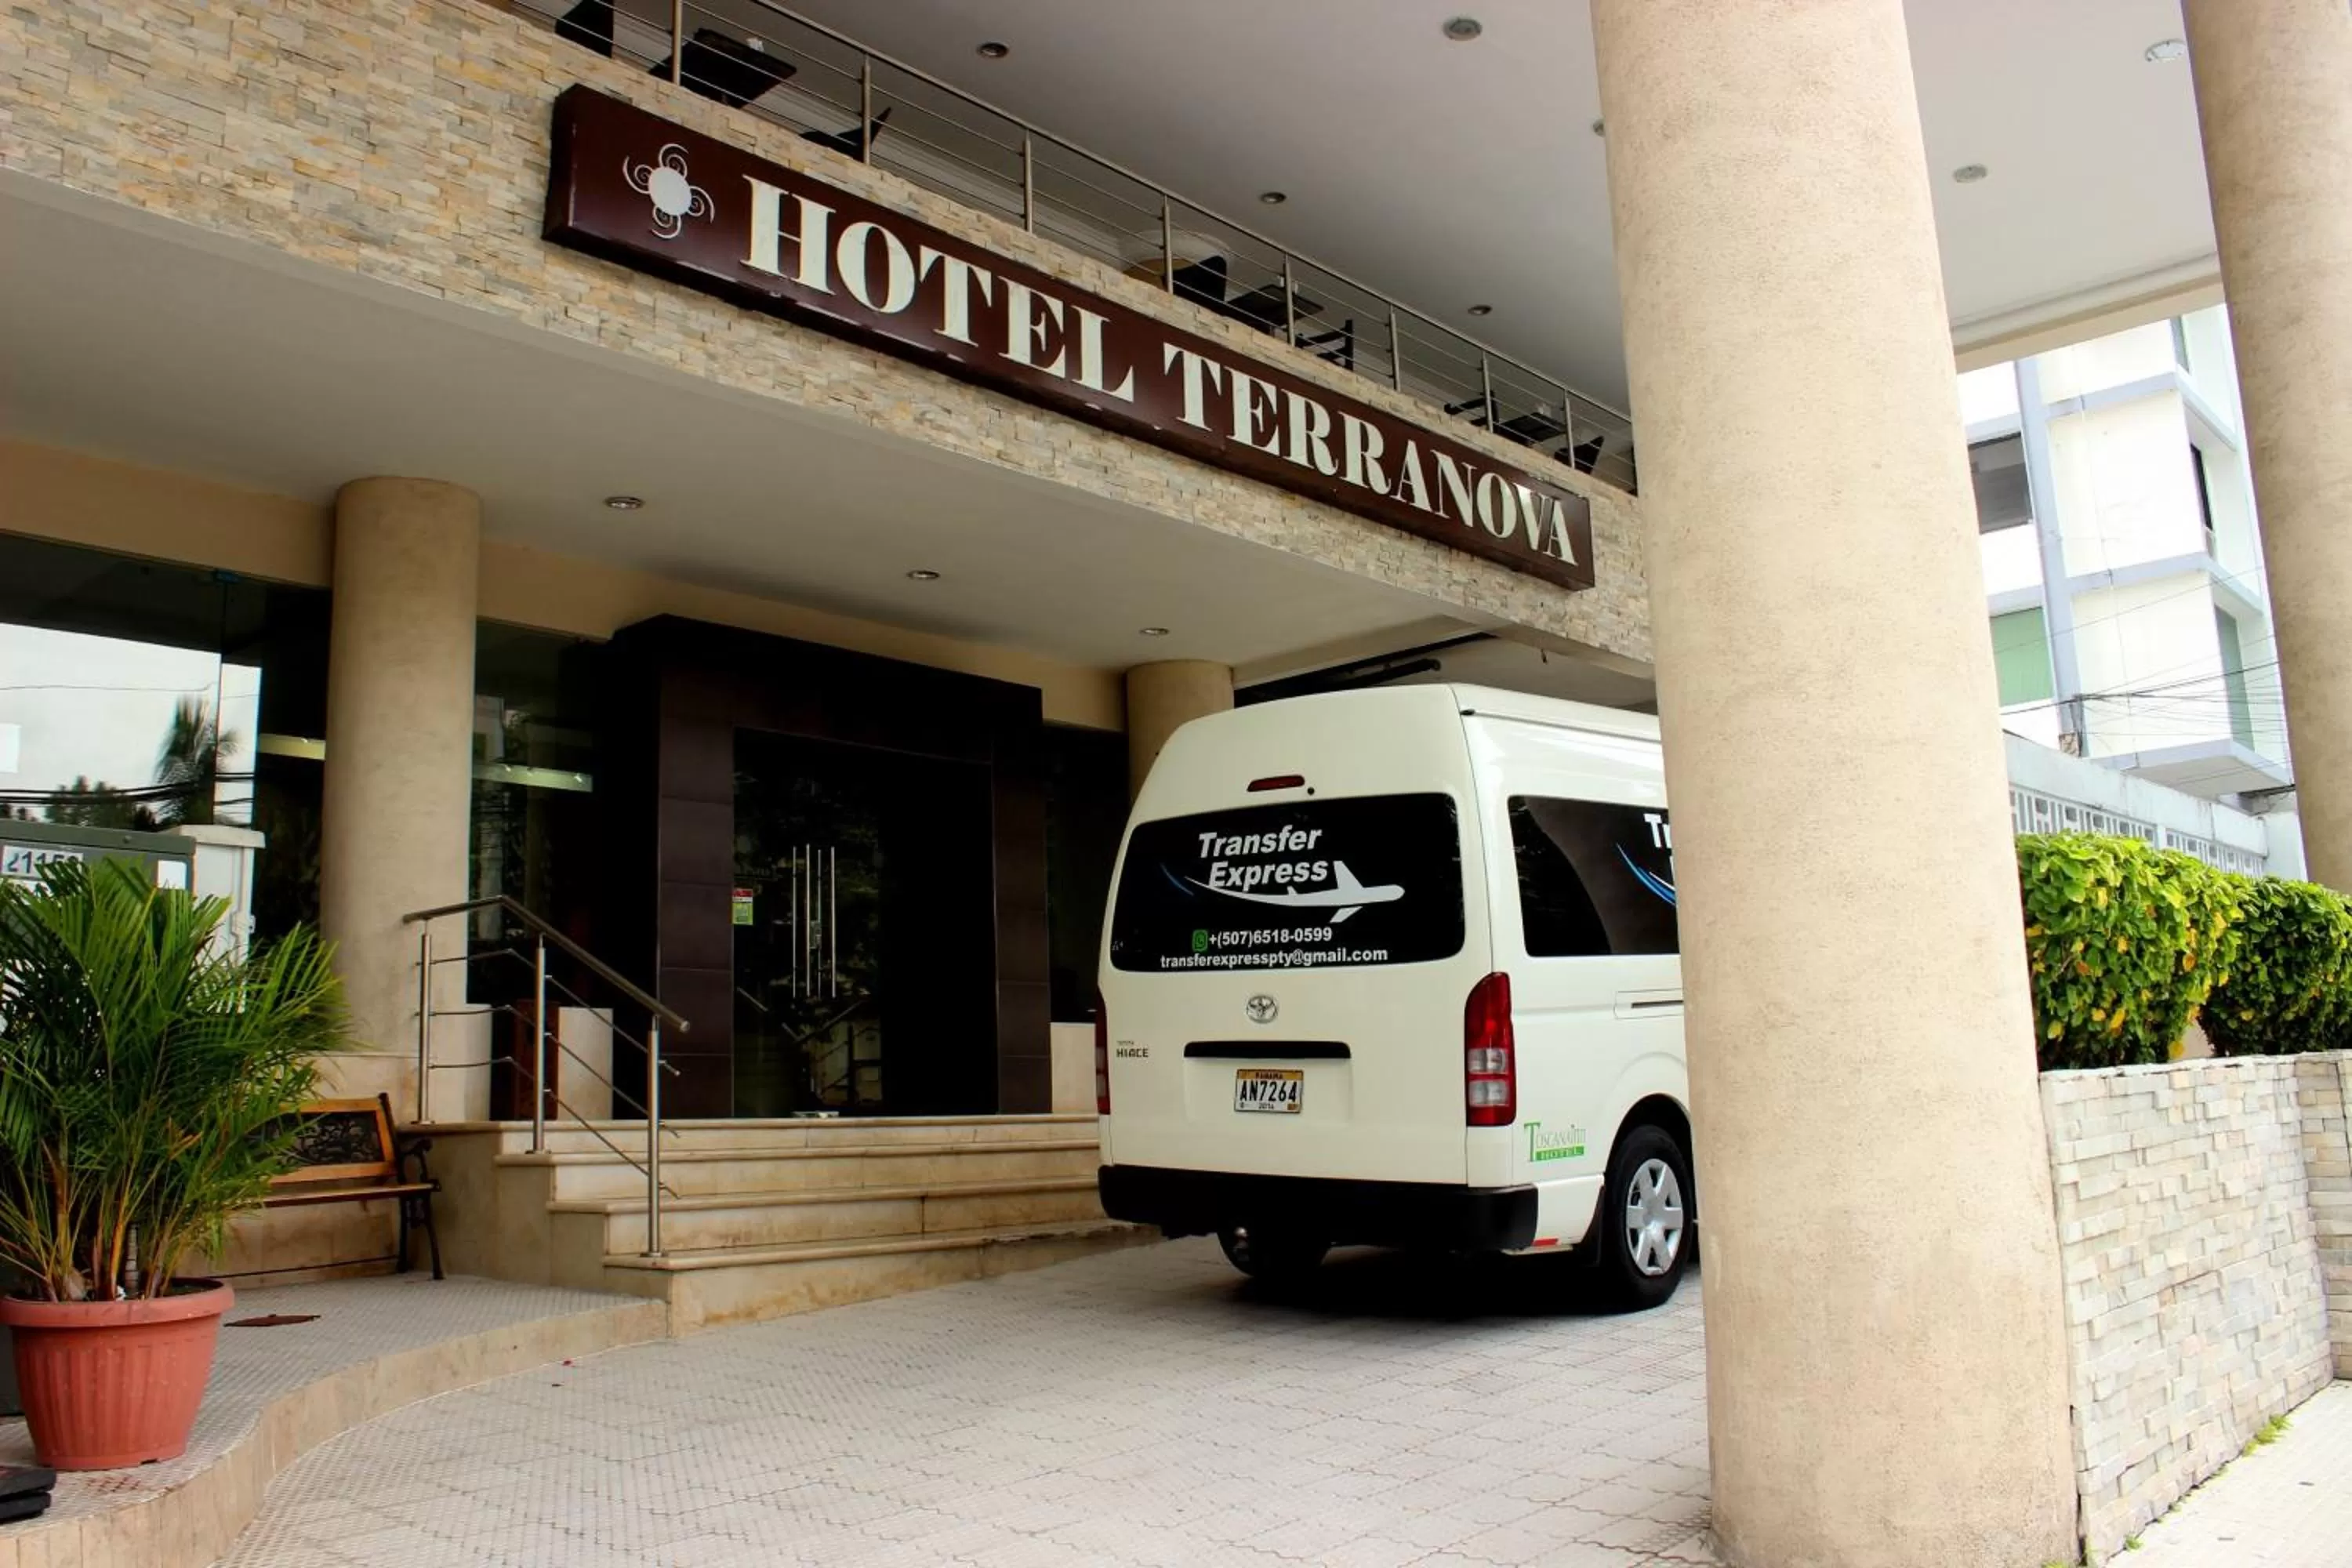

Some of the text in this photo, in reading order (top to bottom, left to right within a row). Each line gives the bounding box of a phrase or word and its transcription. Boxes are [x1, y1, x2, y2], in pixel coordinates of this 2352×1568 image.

[739, 174, 1579, 567] HOTEL TERRANOVA
[1199, 824, 1323, 858] Transfer
[1208, 860, 1329, 893] Express
[1209, 927, 1333, 949] +(507)6518-0599
[1160, 947, 1388, 969] transferexpresspty@gmail.com
[1116, 1048, 1149, 1058] HIACE
[1240, 1080, 1298, 1102] AN7264
